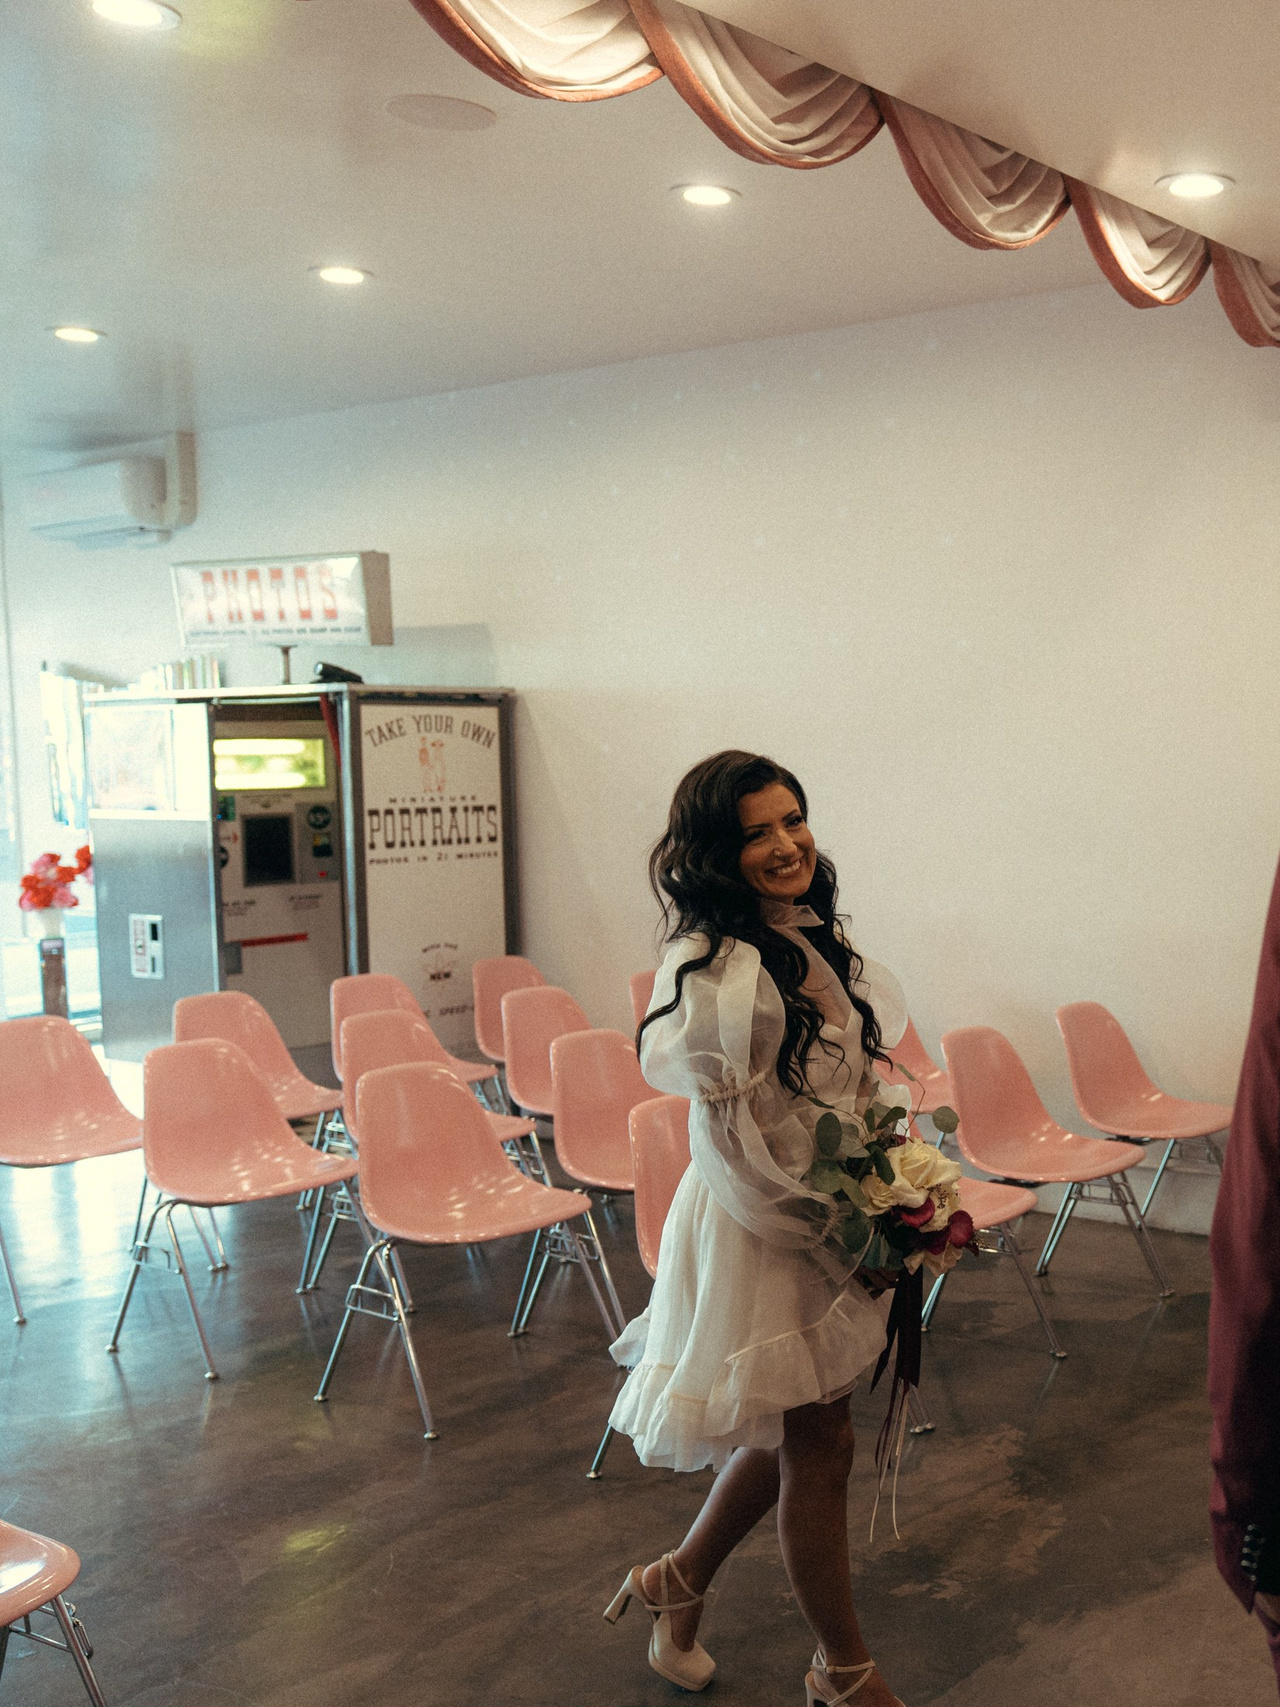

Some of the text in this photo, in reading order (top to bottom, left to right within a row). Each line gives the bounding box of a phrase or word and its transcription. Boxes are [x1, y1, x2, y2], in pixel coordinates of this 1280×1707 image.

[202, 567, 338, 623] PHOTOS
[365, 713, 497, 749] TAKE YOUR OWN
[388, 794, 477, 804] MINIATURE
[367, 804, 498, 850] PORTRAITS
